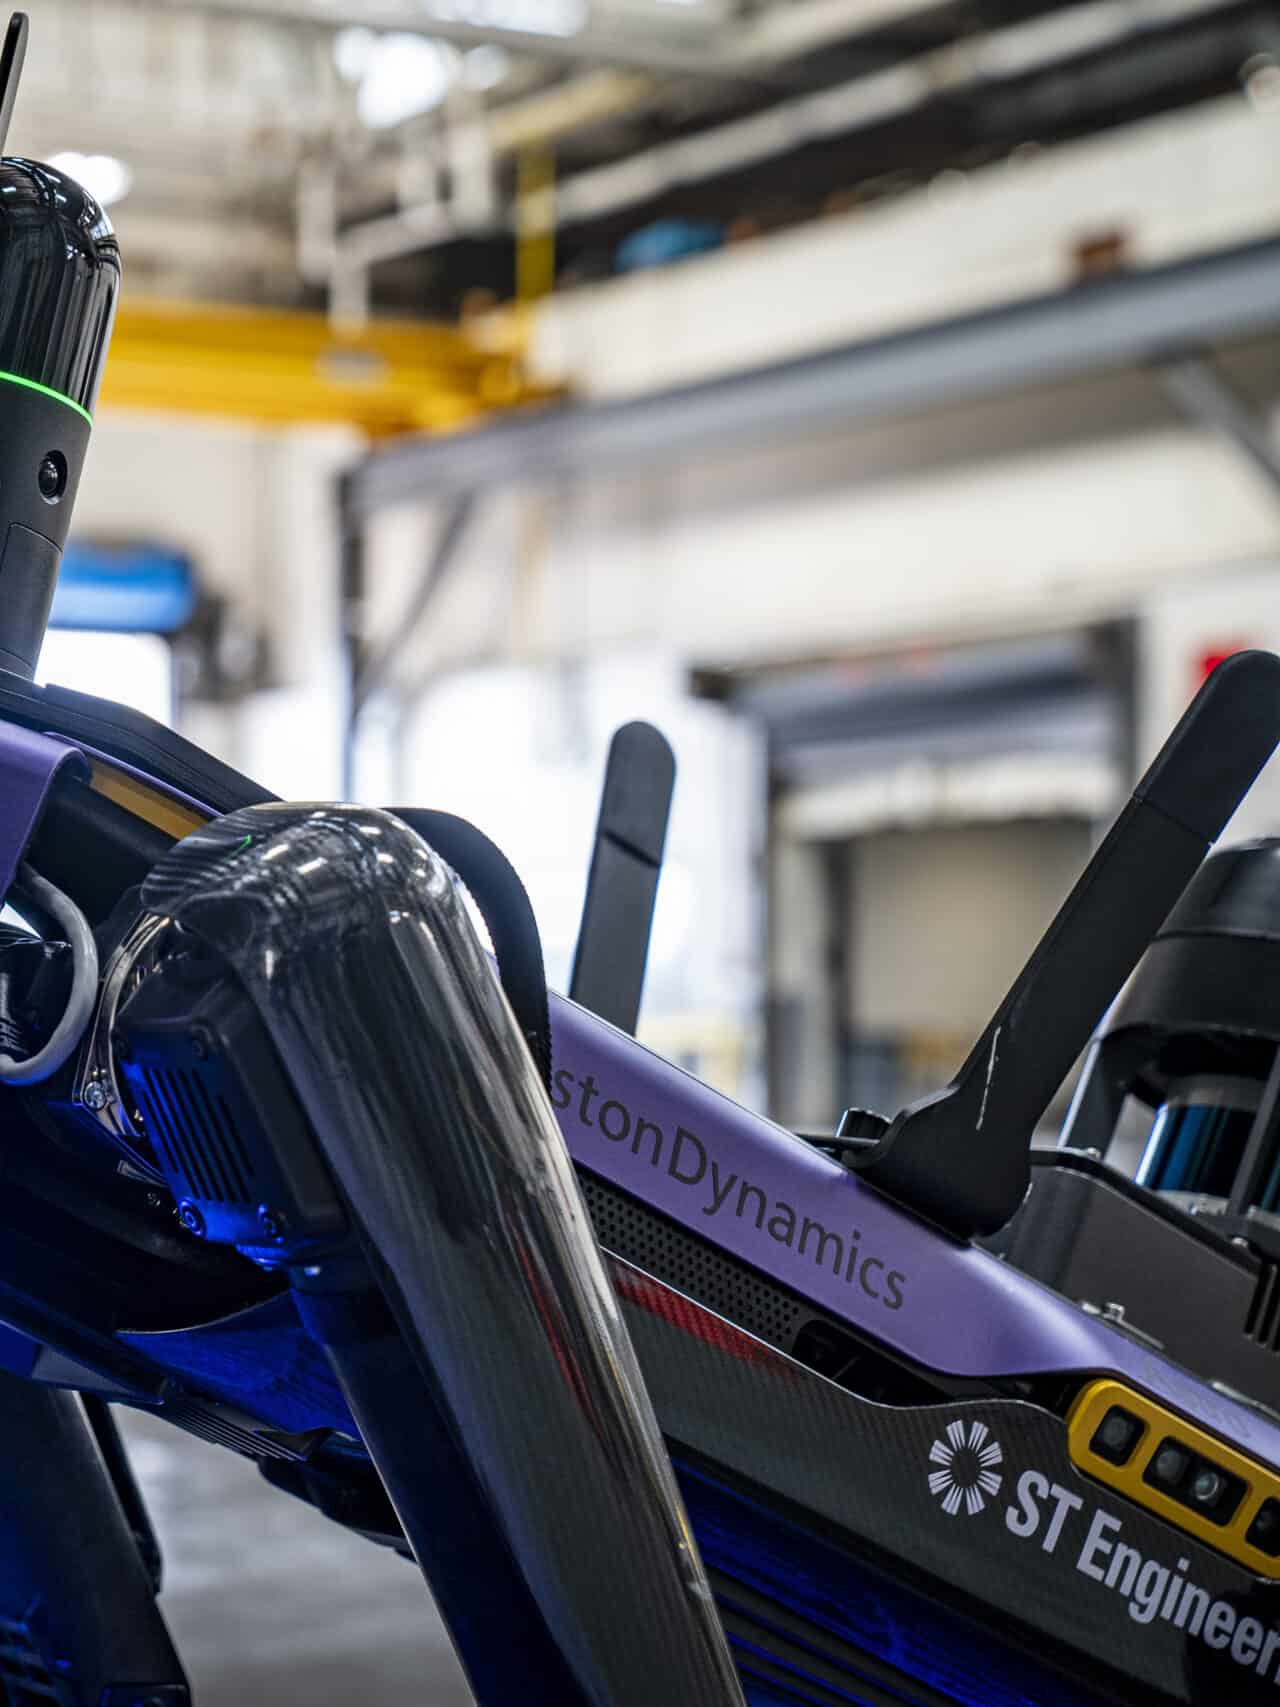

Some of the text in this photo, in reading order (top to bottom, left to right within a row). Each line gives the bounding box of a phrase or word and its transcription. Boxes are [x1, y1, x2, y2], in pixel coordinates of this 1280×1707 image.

[552, 1069, 908, 1311] stonDynamics
[1004, 1470, 1280, 1686] ST Engineer
